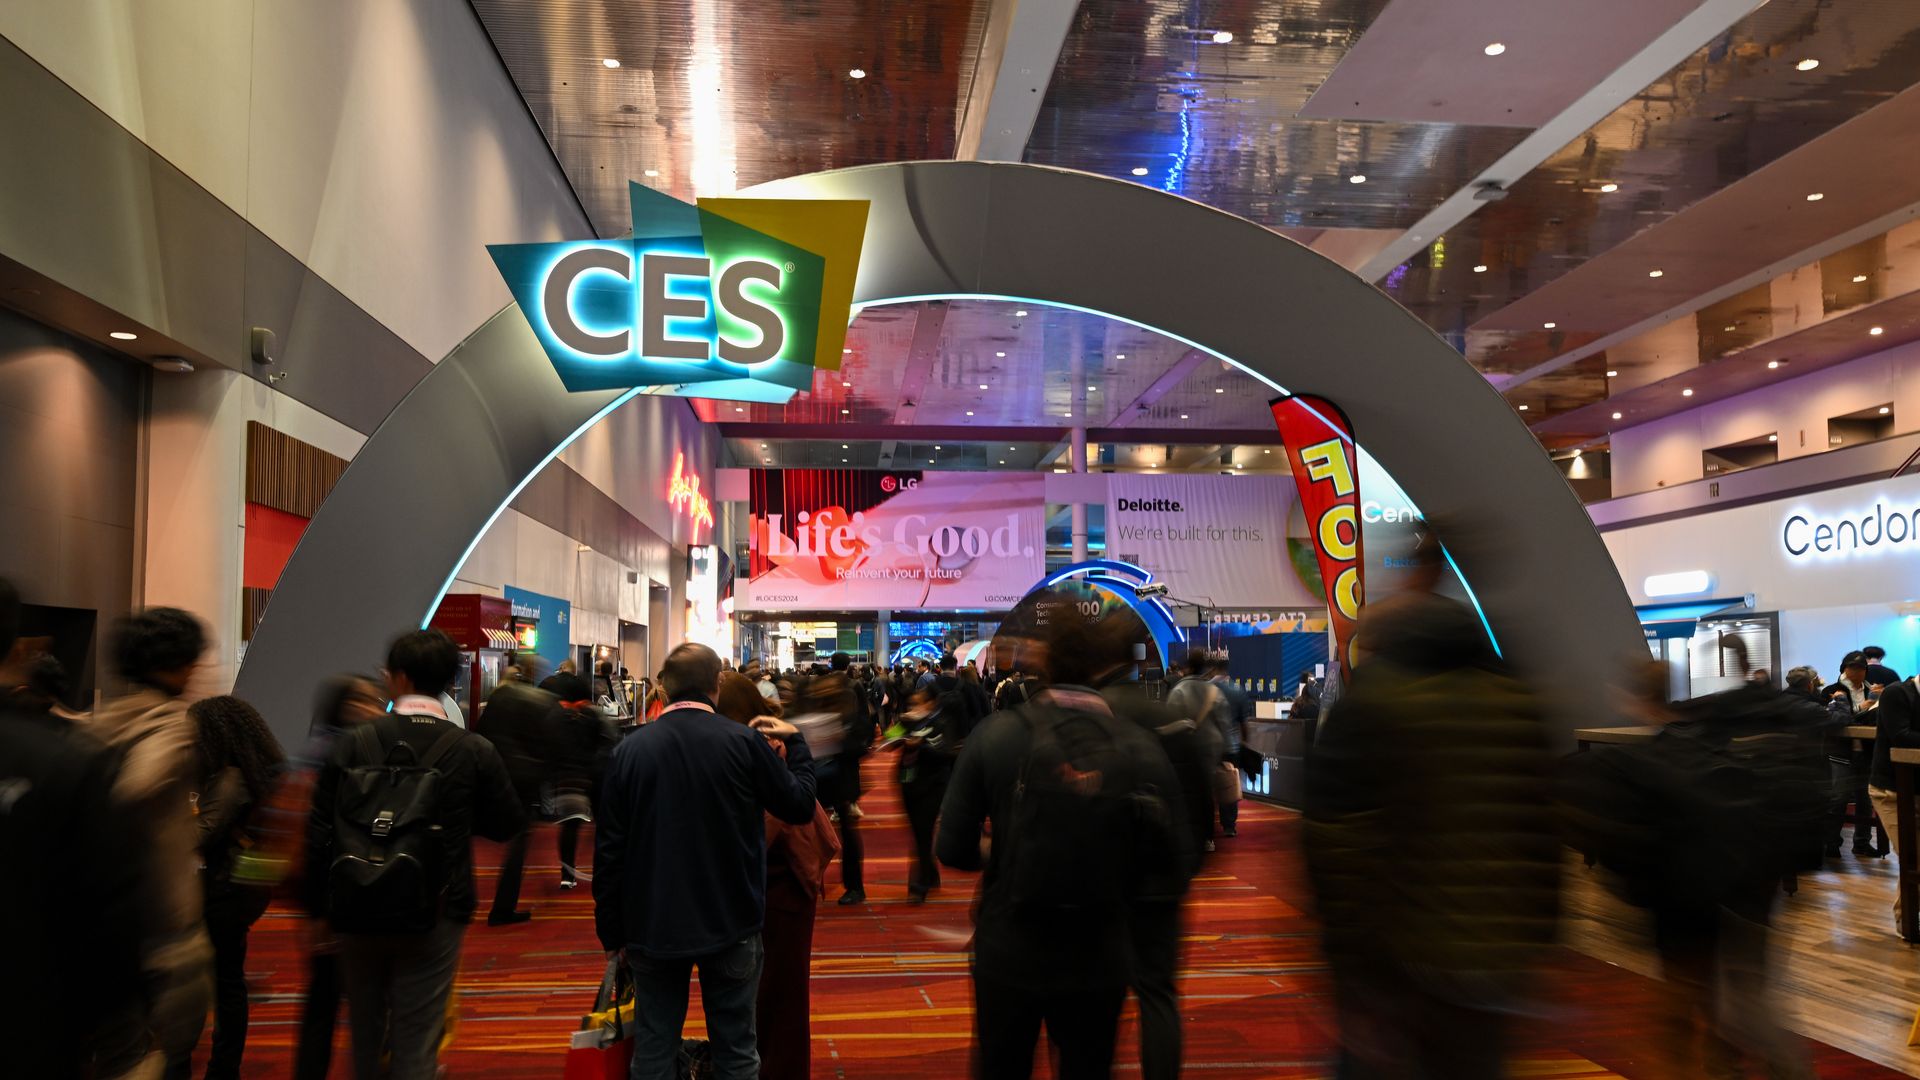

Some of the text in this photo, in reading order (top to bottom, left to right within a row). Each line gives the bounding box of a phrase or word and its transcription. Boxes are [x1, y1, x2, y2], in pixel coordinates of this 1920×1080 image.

[899, 478, 918, 490] LG
[1118, 498, 1184, 512] Deloitte.
[767, 511, 1035, 559] Life's Good.
[1118, 525, 1264, 541] We're built for this.
[836, 567, 962, 583] Reinvent your future
